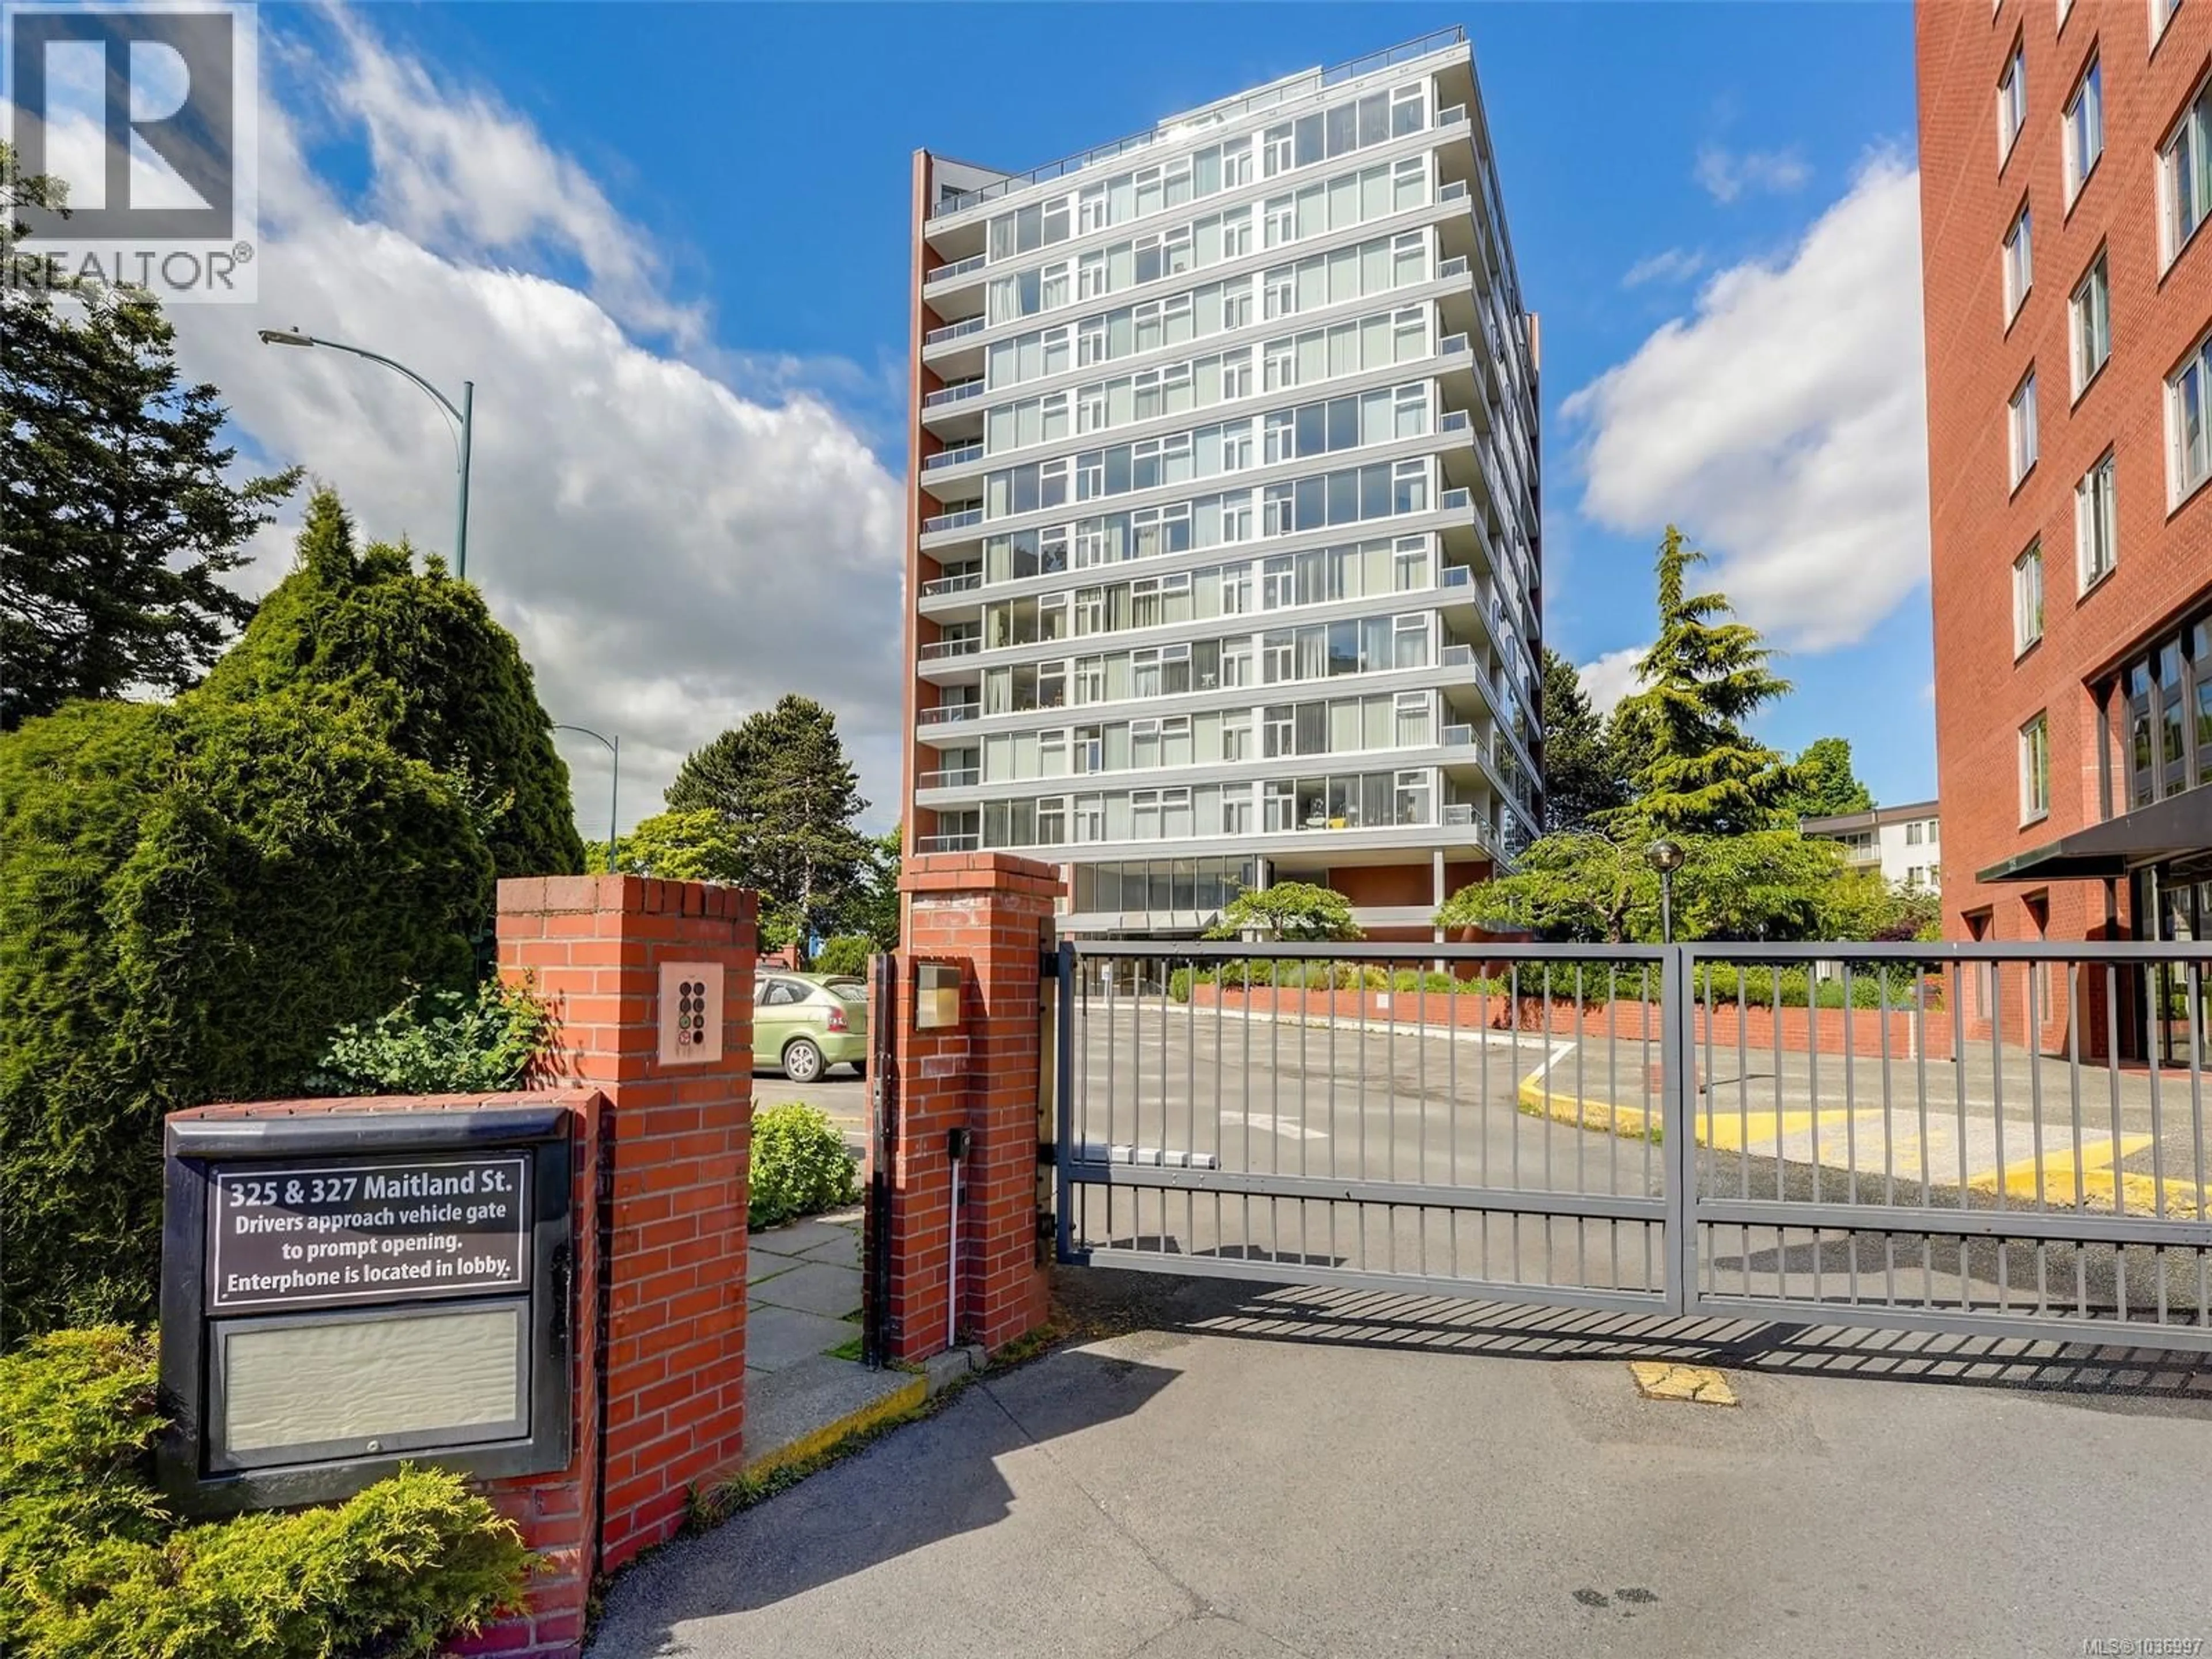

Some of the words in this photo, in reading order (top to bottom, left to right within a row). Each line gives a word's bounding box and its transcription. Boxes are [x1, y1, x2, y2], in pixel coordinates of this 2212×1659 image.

[229, 1181, 278, 1207] 325
[285, 1179, 305, 1205] &
[310, 1177, 358, 1203] 327
[363, 1170, 475, 1200] Maitland
[480, 1169, 513, 1193] St.
[236, 1215, 304, 1234] Drivers
[307, 1207, 395, 1234] approach
[399, 1202, 463, 1224] vehicle
[466, 1202, 507, 1224] gate
[282, 1243, 303, 1260] to
[307, 1237, 378, 1264] prompt
[381, 1233, 463, 1257] opening.
[228, 1270, 341, 1293] Enterphone
[344, 1266, 360, 1284] is
[363, 1260, 431, 1283] located
[435, 1259, 453, 1277] in
[457, 1255, 512, 1278] lobby.
